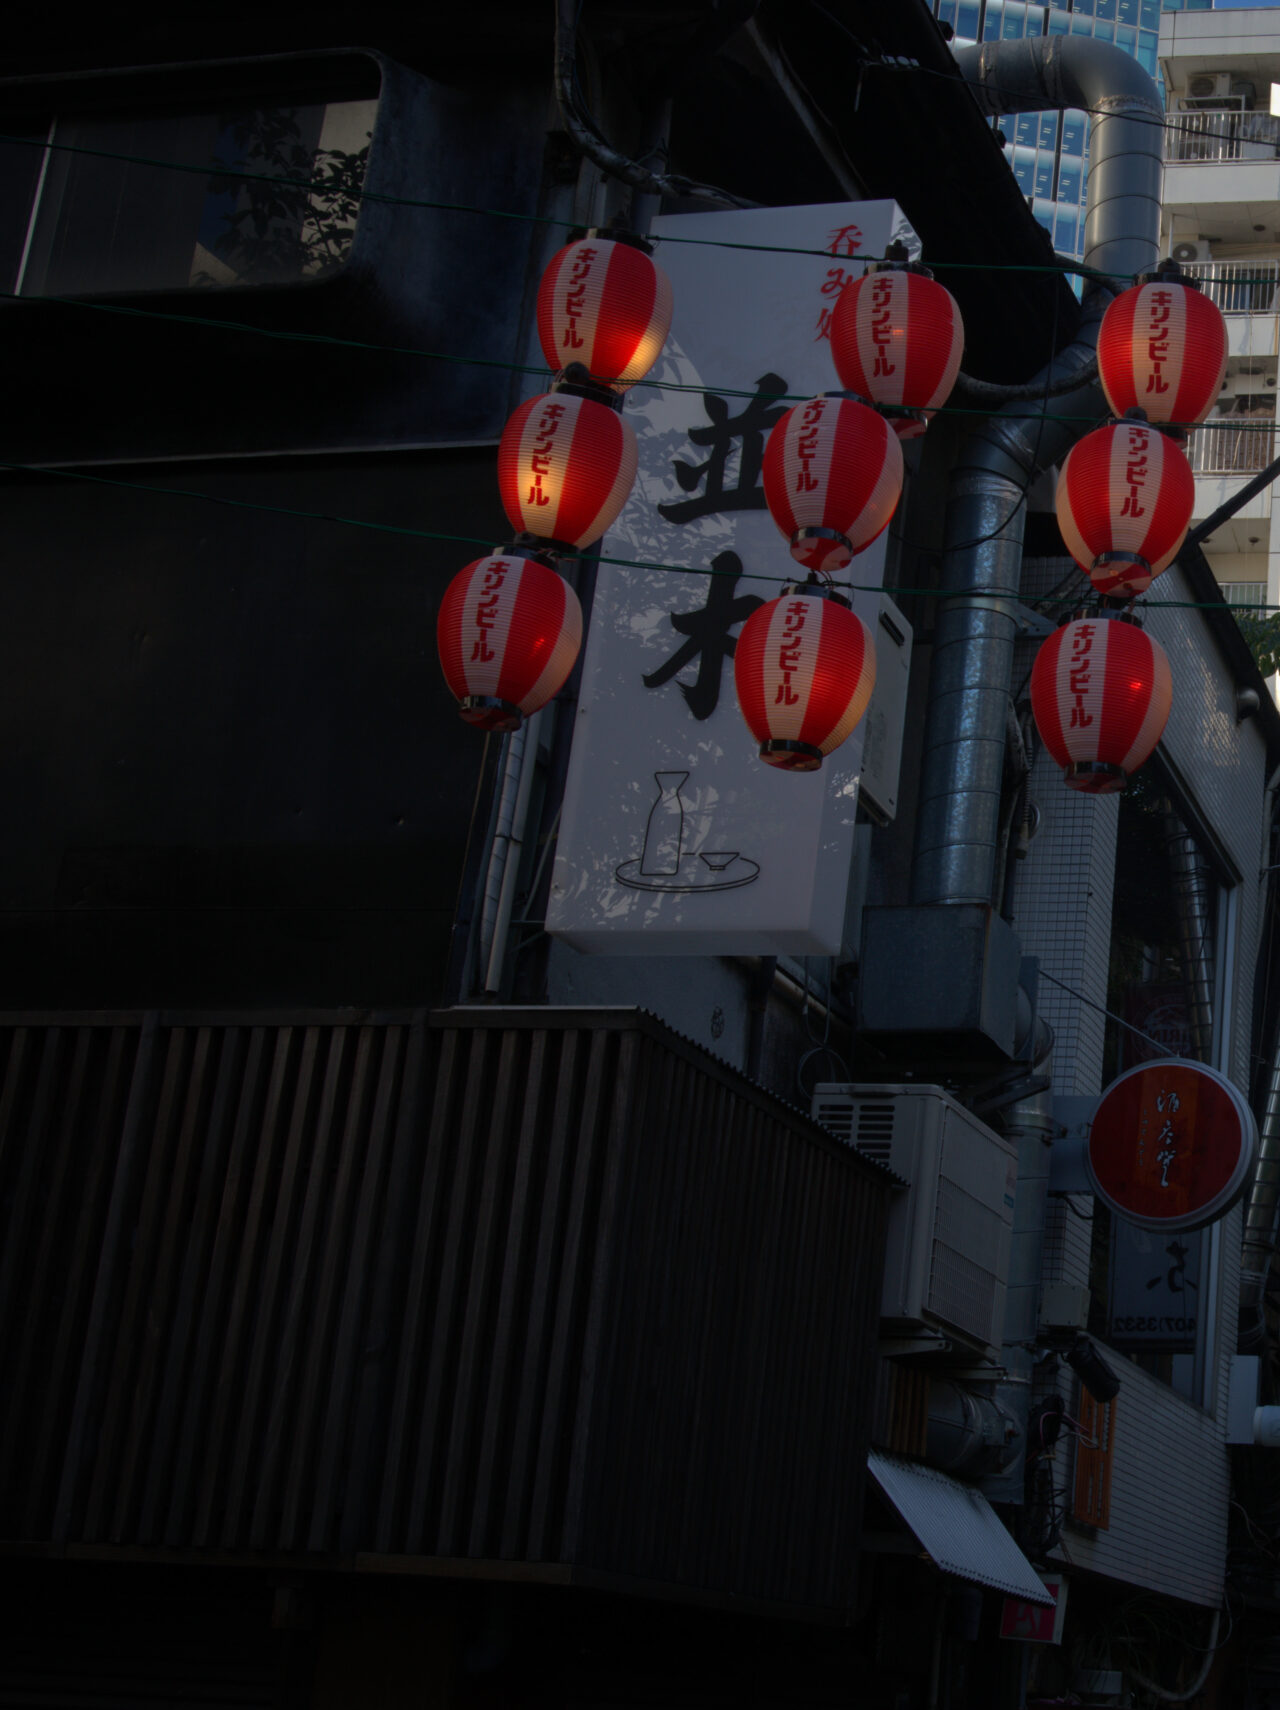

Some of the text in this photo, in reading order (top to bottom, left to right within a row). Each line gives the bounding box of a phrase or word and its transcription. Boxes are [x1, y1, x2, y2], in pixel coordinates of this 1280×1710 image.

[562, 247, 600, 349] キリンビール
[871, 277, 896, 378] キリンビール
[1146, 290, 1172, 394] キリンビール
[527, 403, 566, 507] キリンビール
[795, 398, 829, 492] キリンビール
[1119, 427, 1150, 519] キリンビール
[470, 560, 511, 663] キリンビール
[774, 600, 811, 706] キリンビール
[1070, 624, 1096, 728] キリンビール
